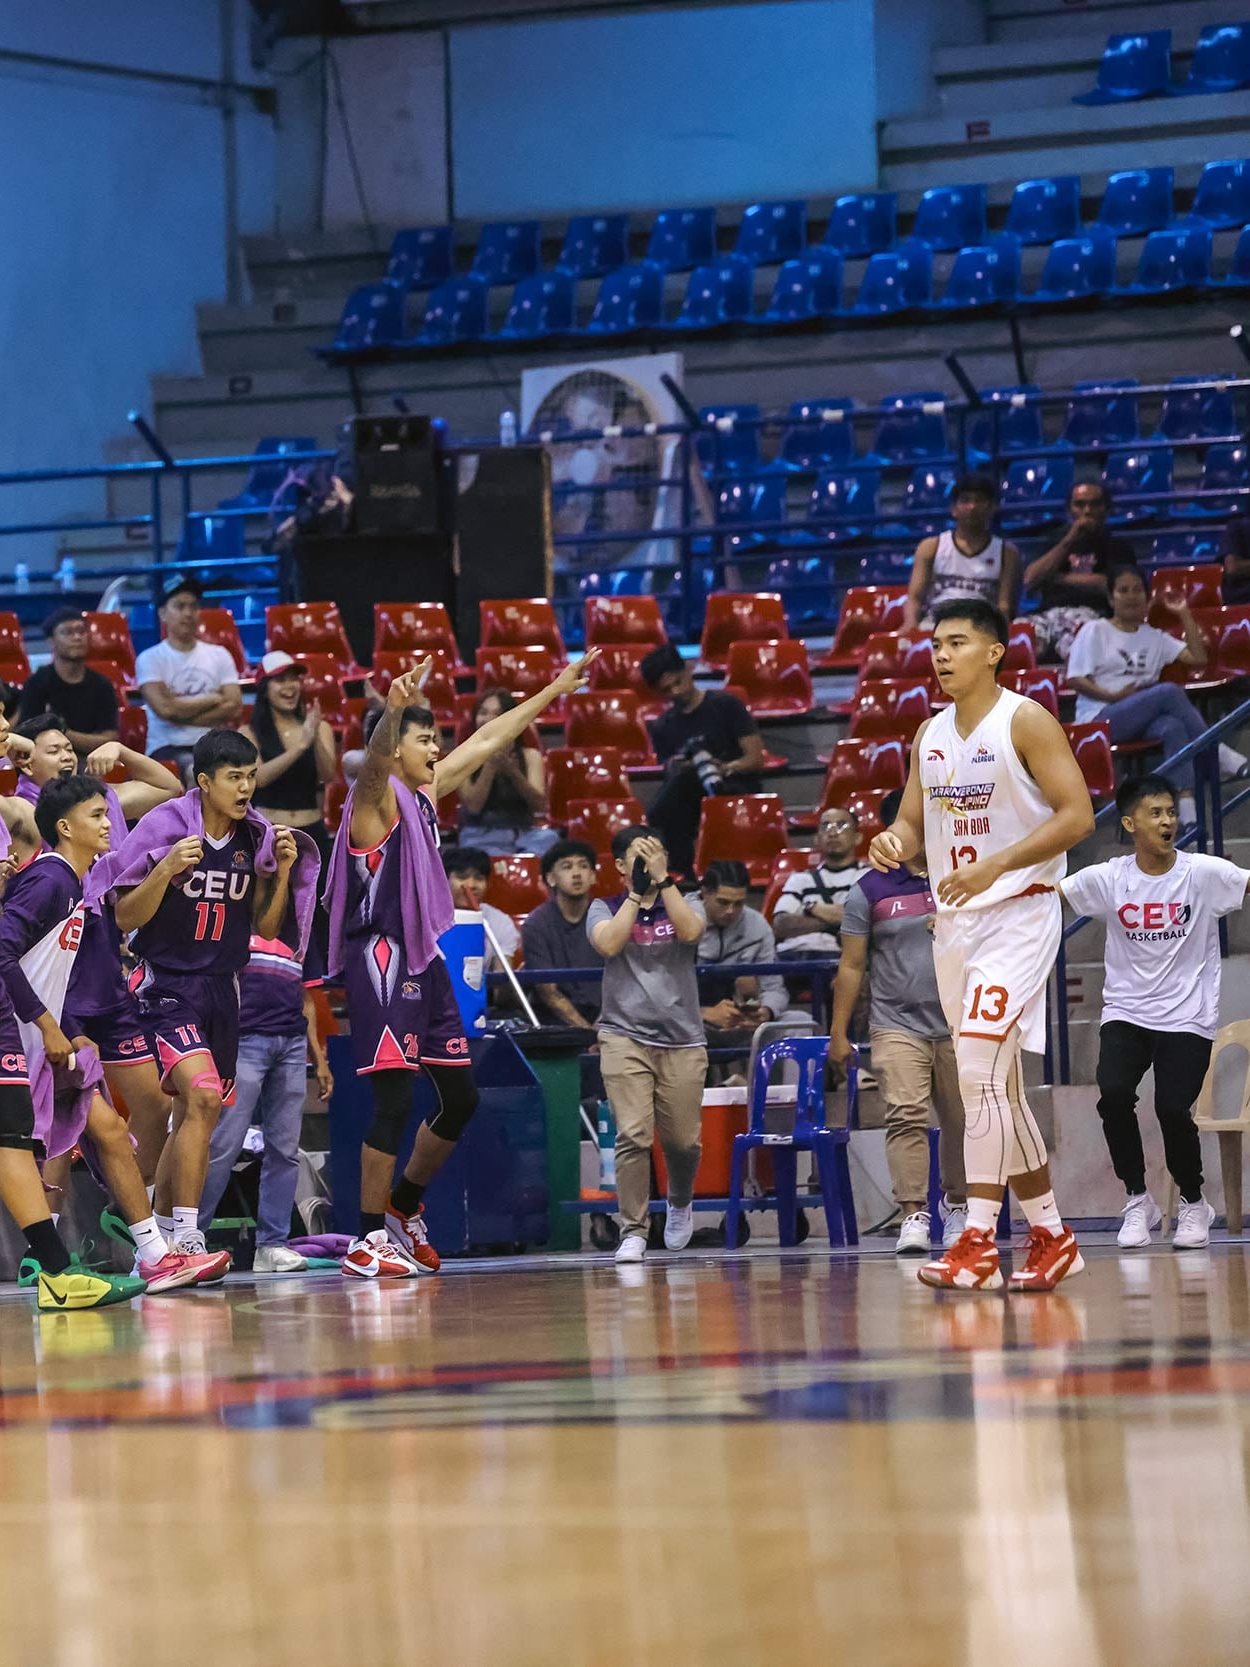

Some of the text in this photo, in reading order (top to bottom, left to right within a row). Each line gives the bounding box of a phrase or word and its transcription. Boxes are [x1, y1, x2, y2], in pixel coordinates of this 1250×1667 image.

[183, 869, 251, 901] CEU
[195, 901, 226, 941] 11
[1117, 902, 1192, 928] CEU
[654, 924, 676, 937] CE
[1125, 928, 1188, 942] BASKETBALL
[968, 983, 1010, 1023] 13
[117, 1034, 149, 1055] CE
[174, 1023, 202, 1047] 11
[445, 1037, 469, 1055] CE
[0, 1053, 28, 1073] CE
